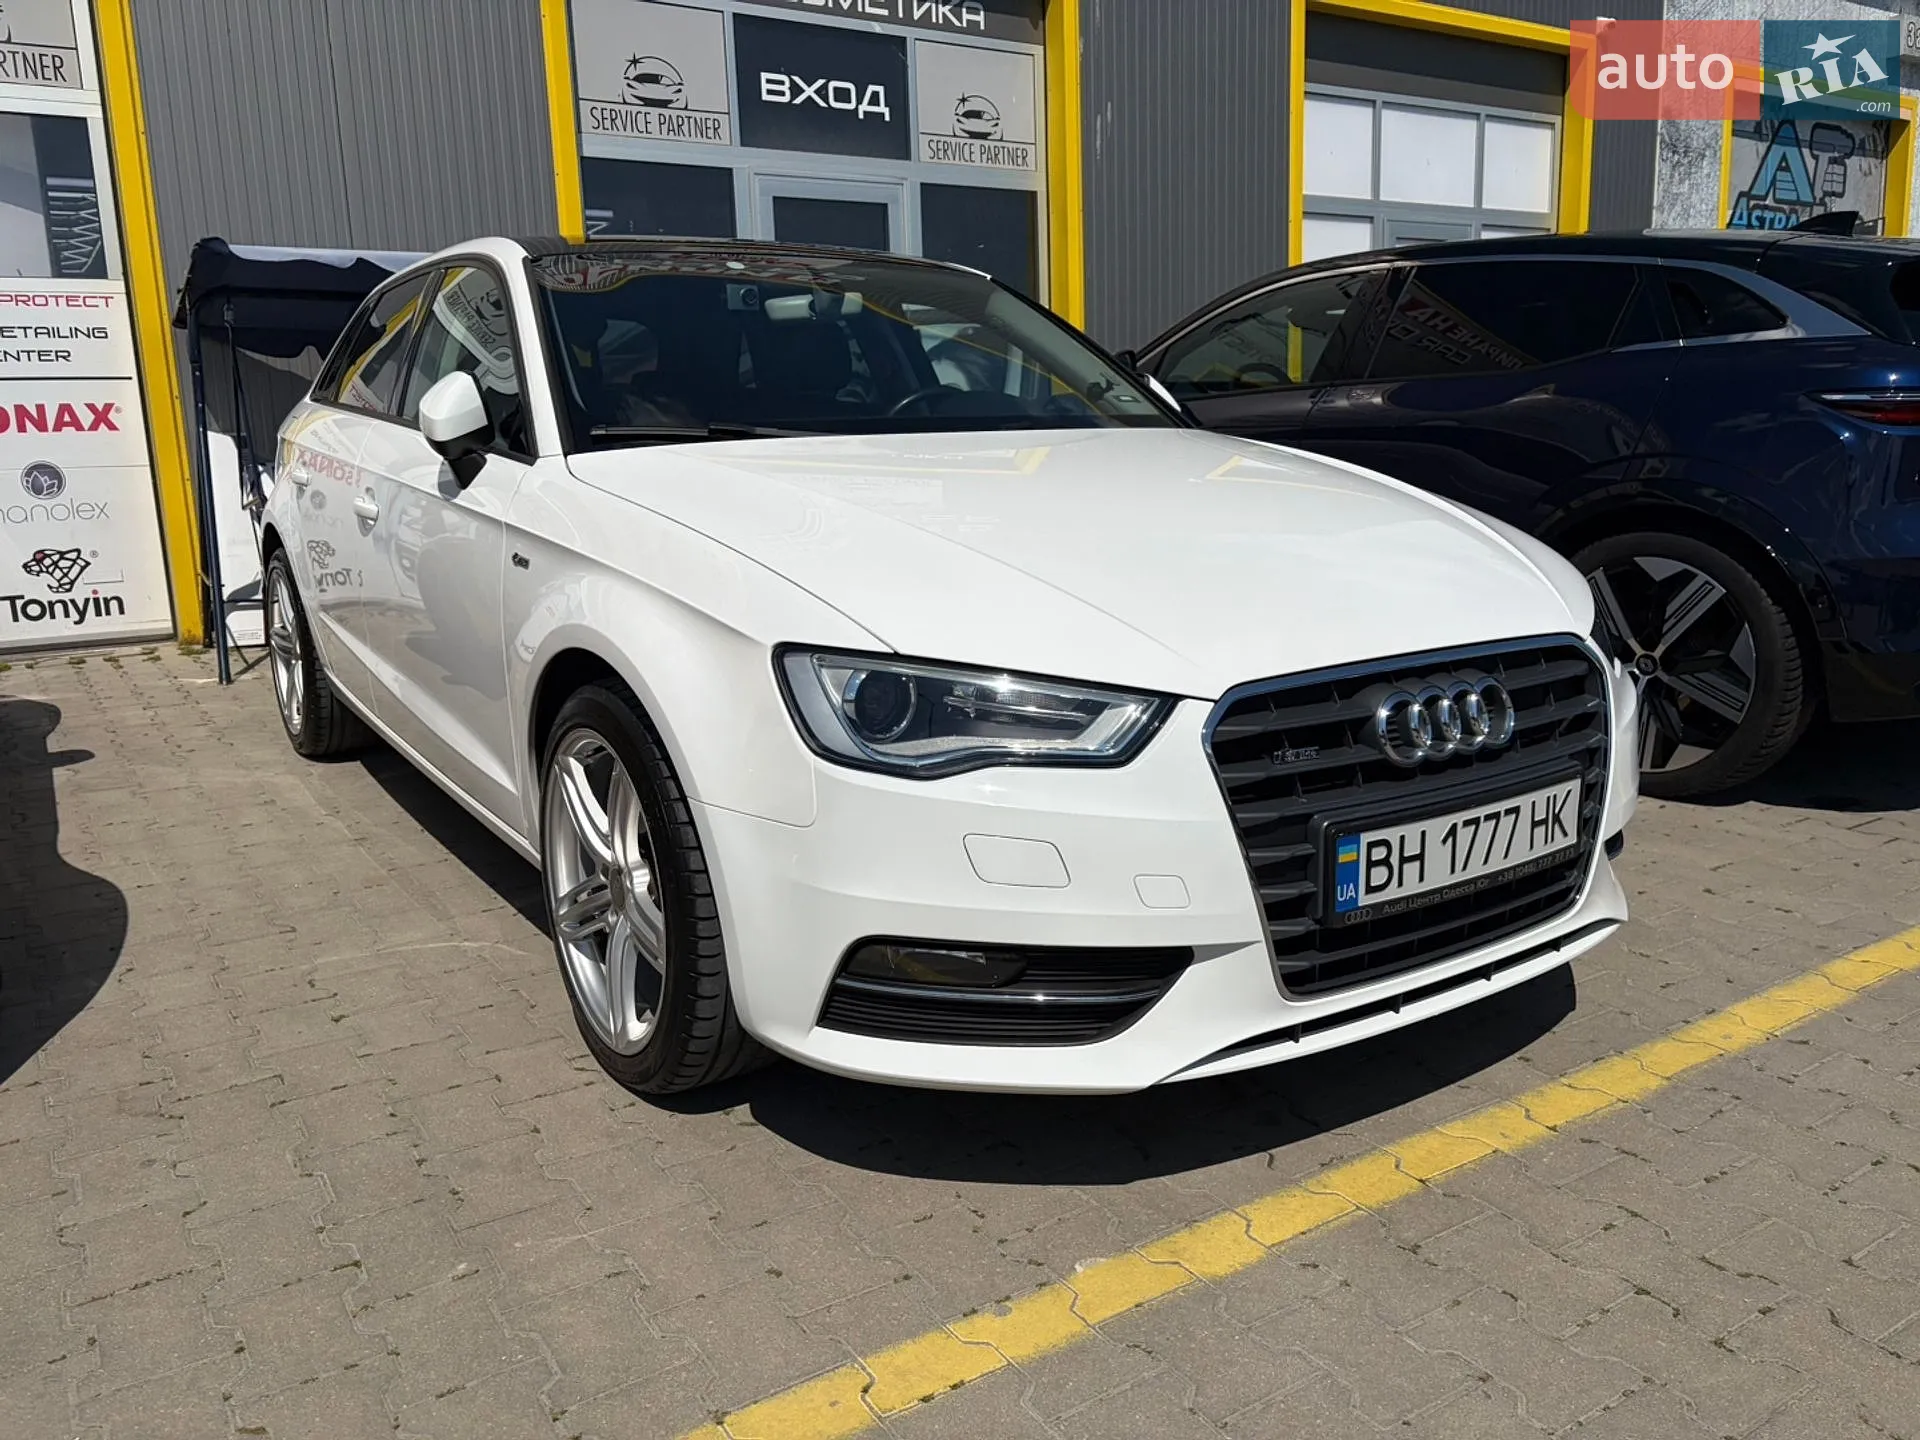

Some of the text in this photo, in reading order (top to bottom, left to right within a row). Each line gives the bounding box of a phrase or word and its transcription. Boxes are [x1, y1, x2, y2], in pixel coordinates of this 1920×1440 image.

[760, 71, 891, 122] ВХОД
[589, 106, 722, 141] SERVICE PARTNER
[927, 139, 1030, 168] SERVICE PARTNER
[0, 293, 114, 308] PROTECT
[0, 350, 72, 362] NTER
[0, 589, 125, 625] Tonyin
[1364, 787, 1573, 896] BH 1777 HK
[1337, 883, 1357, 902] UA
[1382, 898, 1404, 914] Audi
